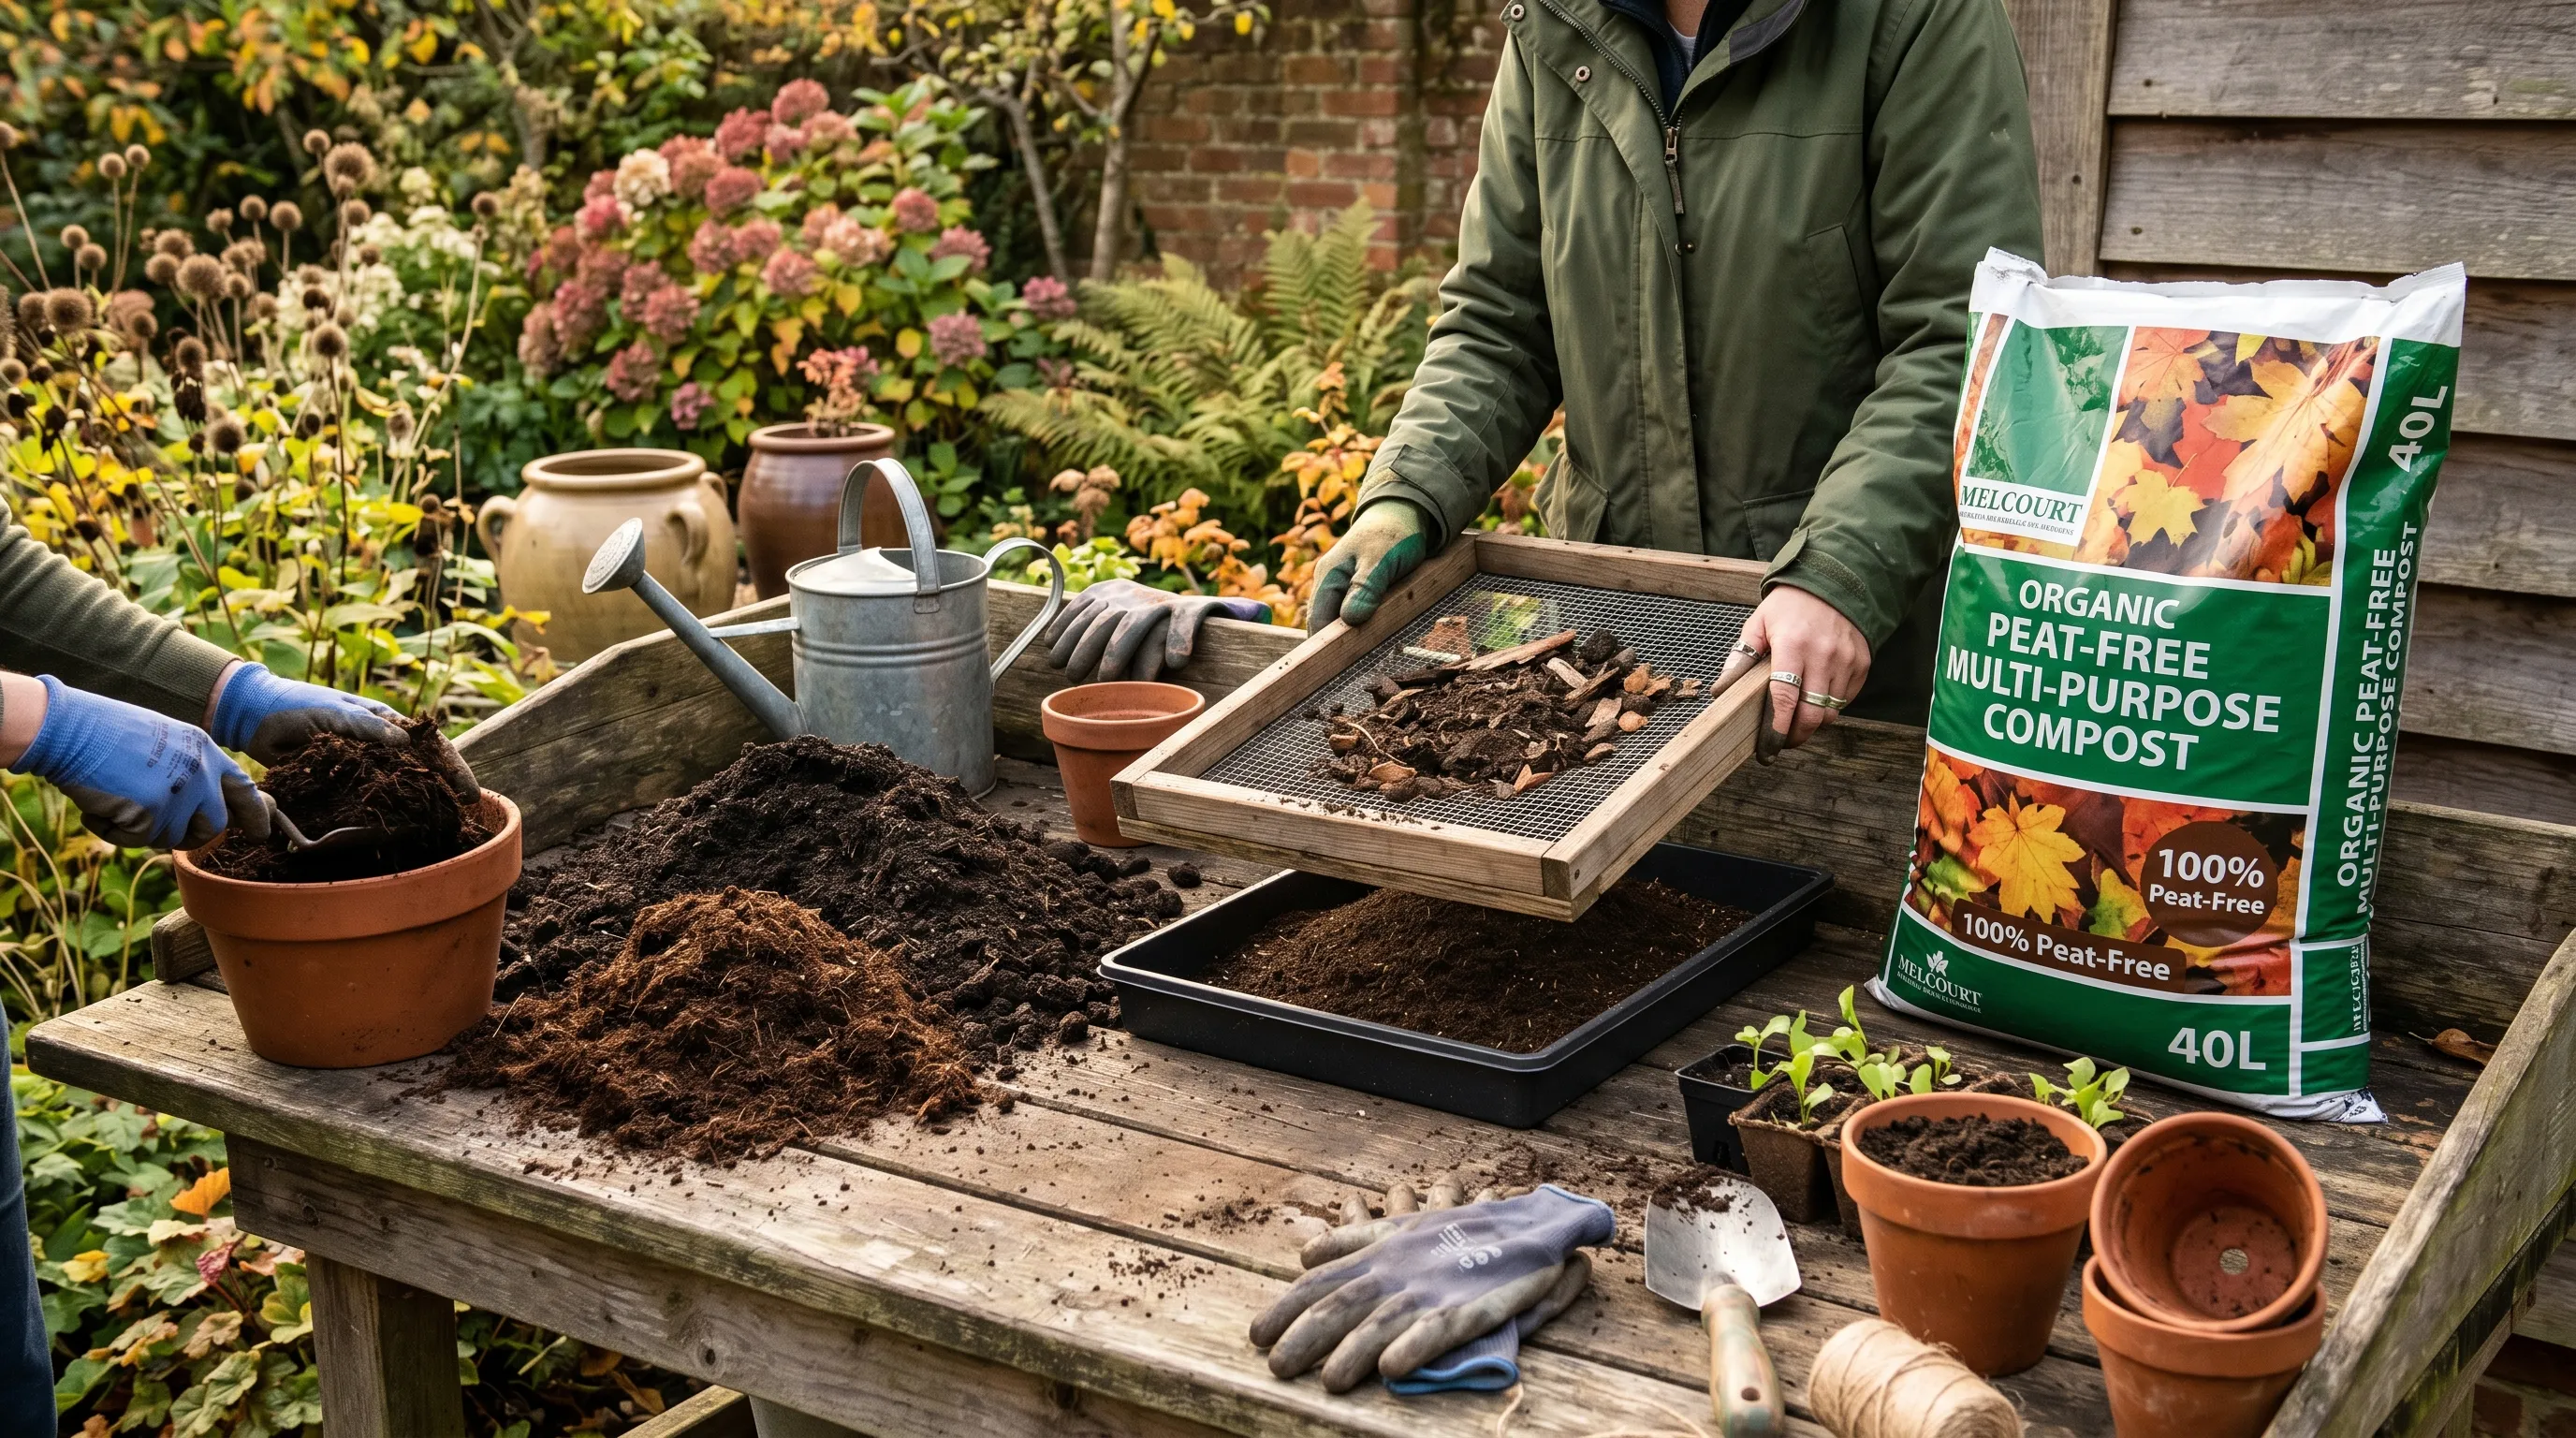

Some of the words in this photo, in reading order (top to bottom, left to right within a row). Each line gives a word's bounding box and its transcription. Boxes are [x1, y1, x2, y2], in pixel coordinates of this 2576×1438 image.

[2388, 385, 2449, 473] 40L
[1959, 485, 2084, 523] MELCOURT
[2019, 579, 2180, 630] ORGANIC
[2355, 549, 2396, 723] PEAT-FREE
[1986, 611, 2211, 681] PEAT-FREE
[1946, 644, 2281, 733] MULTI-PURPOSE
[2356, 677, 2396, 915] MULTI-PURPOSE
[2385, 521, 2418, 672] COMPOST
[1983, 702, 2200, 770] COMPOST
[2336, 732, 2375, 888] ORGANIC
[2148, 883, 2265, 916] Peat-Free
[2159, 848, 2265, 888] 100%
[1897, 953, 1983, 1006] MELCOURT
[1962, 913, 2029, 953] 100%
[2036, 932, 2171, 982] Peat-Free
[2167, 1027, 2267, 1071] 40L
